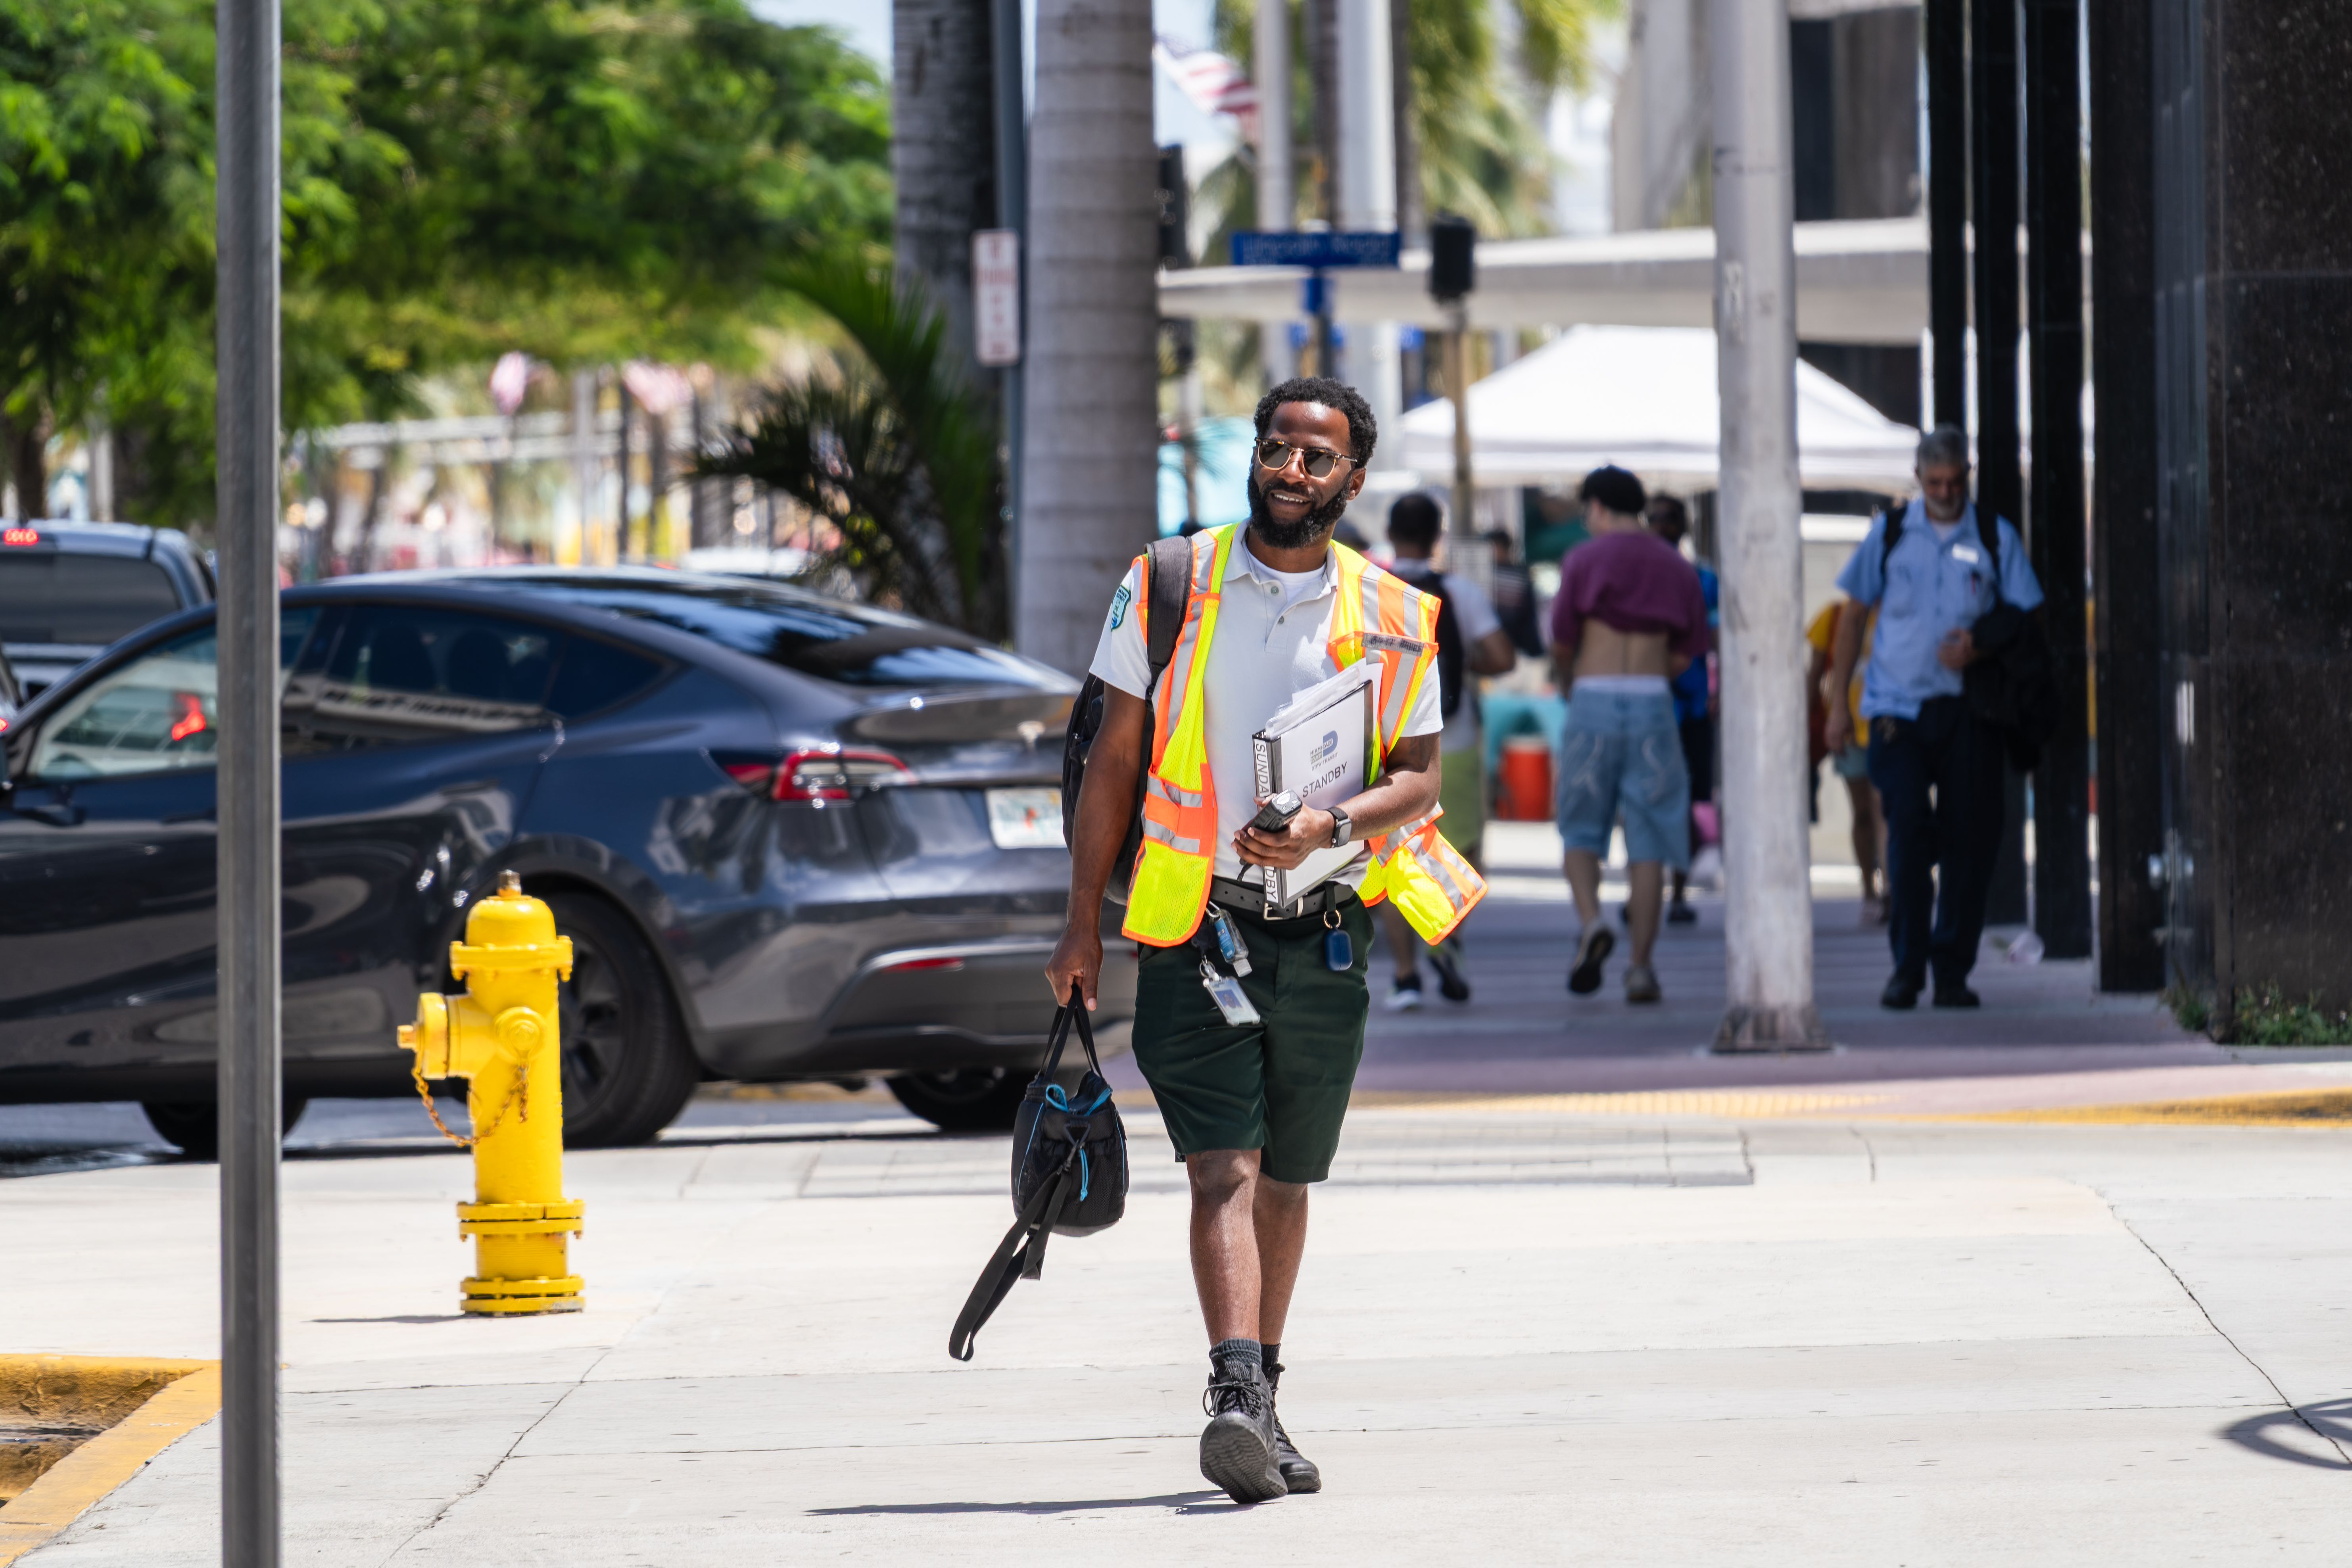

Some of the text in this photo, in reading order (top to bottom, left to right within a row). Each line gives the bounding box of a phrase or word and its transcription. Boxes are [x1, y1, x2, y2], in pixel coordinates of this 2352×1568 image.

[1310, 739, 1333, 756] MIAMI DADE
[1256, 743, 1269, 793] SUNDA
[1311, 752, 1338, 772] DTPW TRANSIT
[1303, 761, 1347, 798] STANDBY
